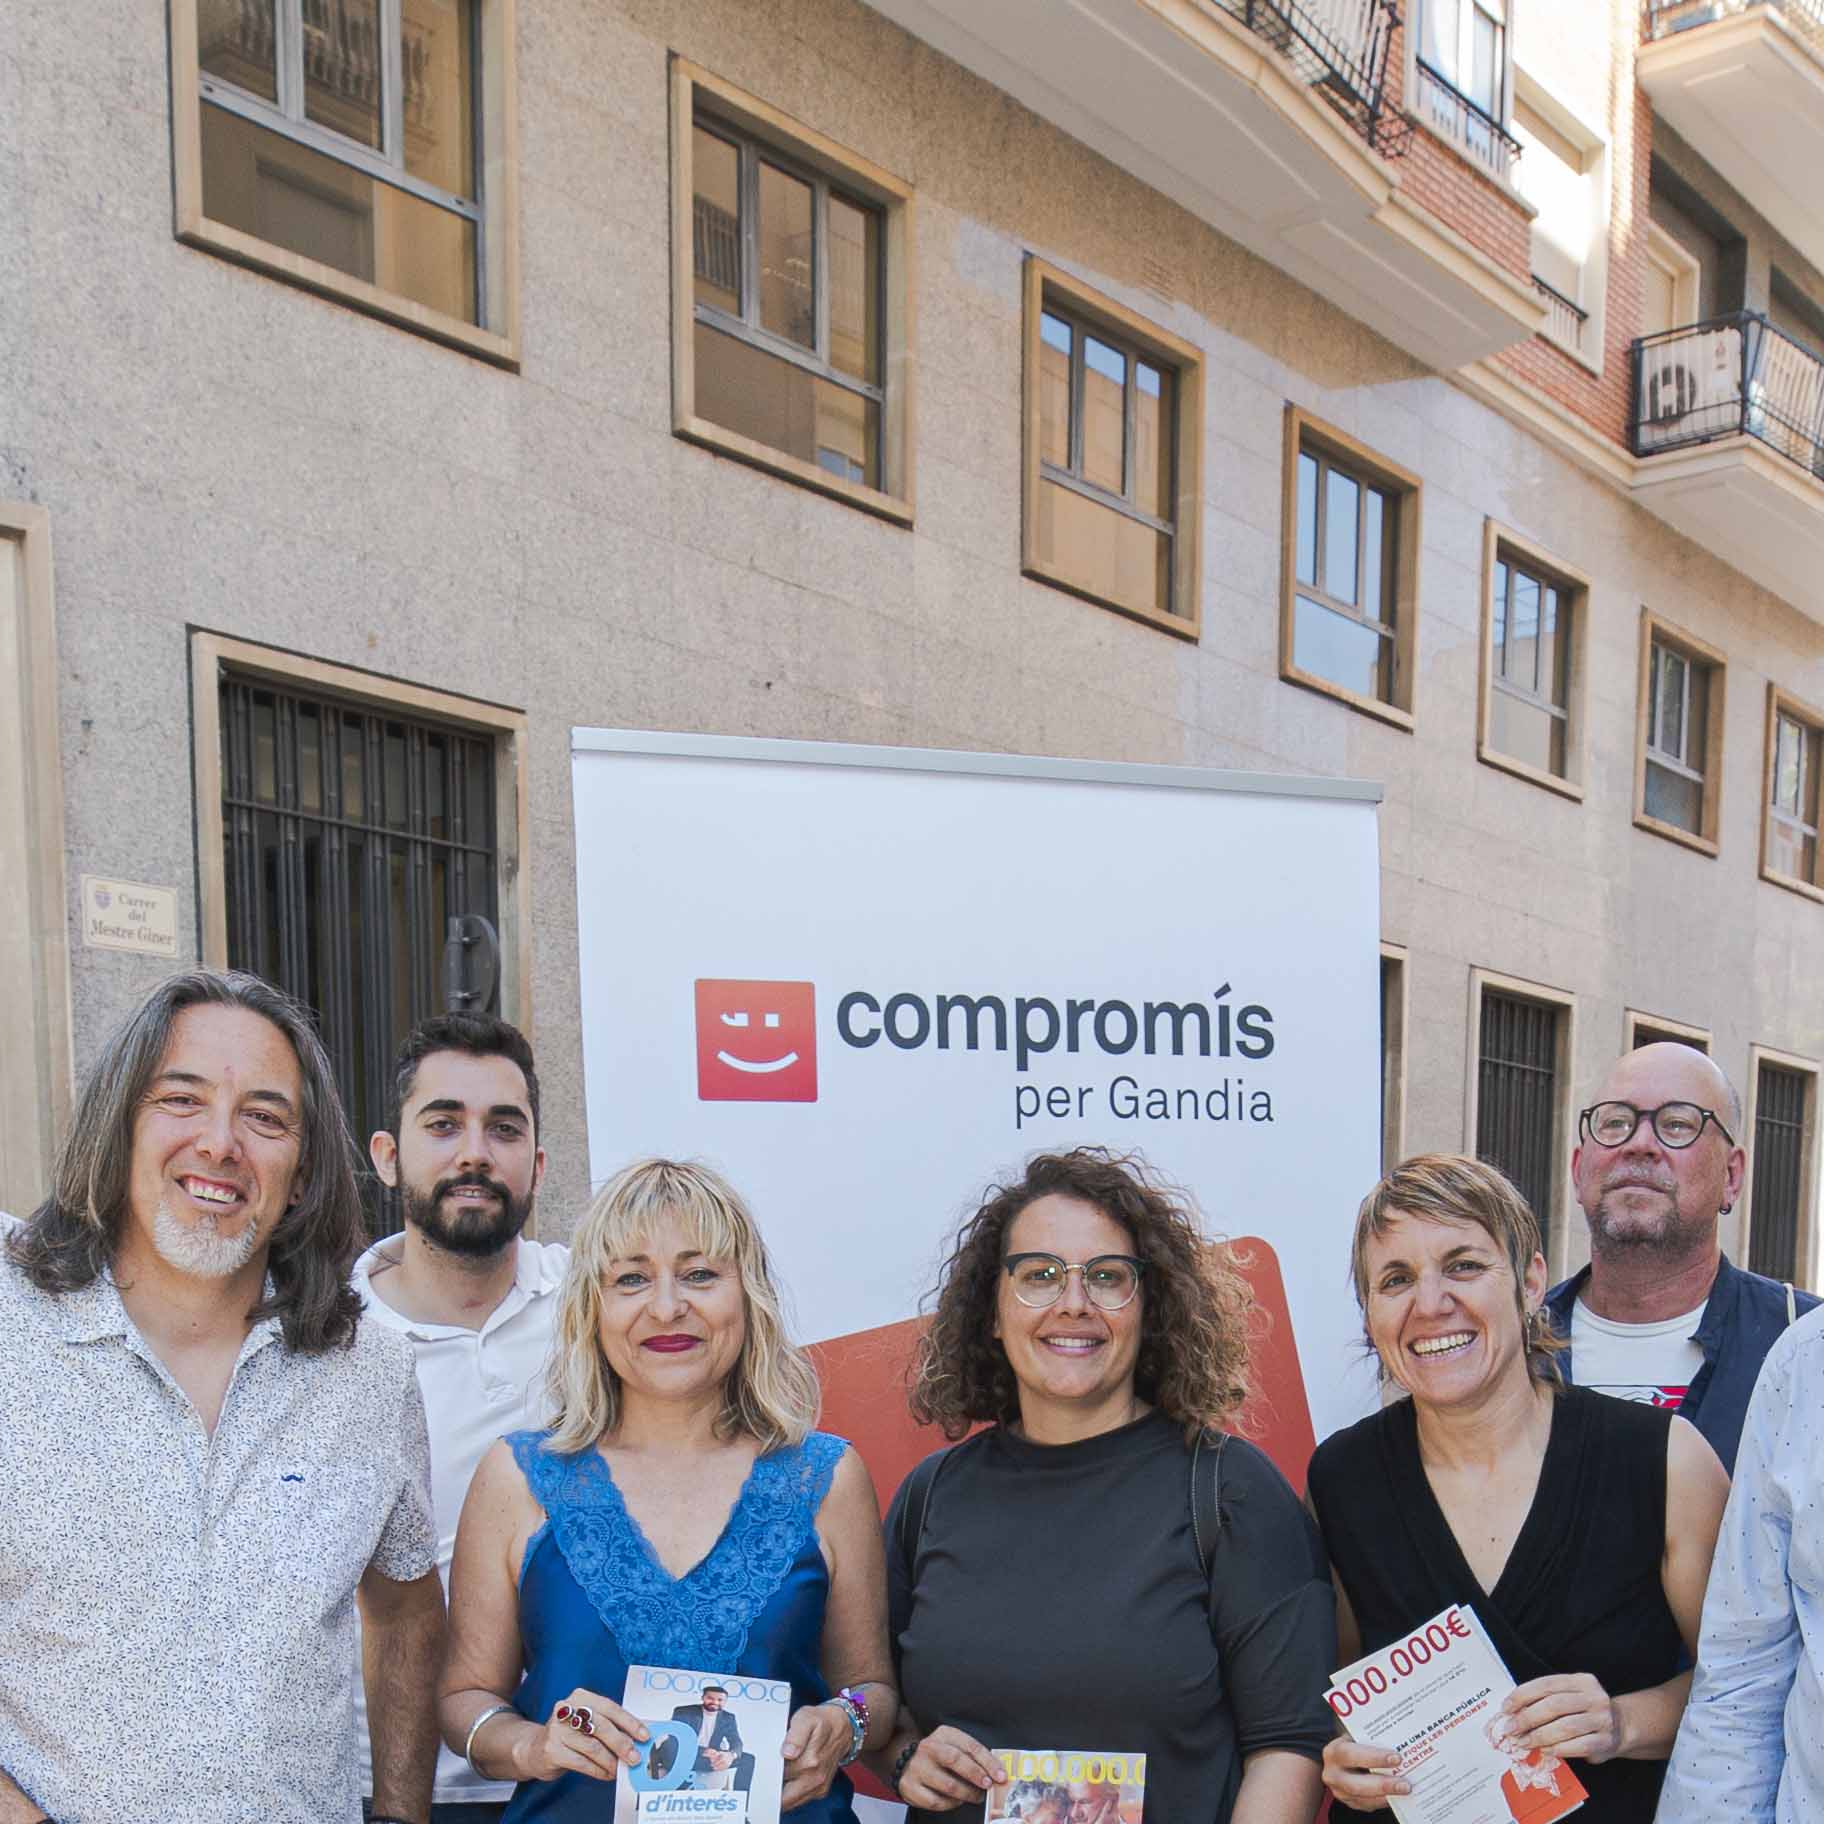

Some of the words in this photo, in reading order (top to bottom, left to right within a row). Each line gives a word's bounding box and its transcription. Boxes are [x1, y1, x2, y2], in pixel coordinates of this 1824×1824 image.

[117, 893, 158, 910] Carrer
[836, 982, 1275, 1072] compromís
[1015, 1084, 1094, 1130] per
[1108, 1075, 1275, 1123] Gandia
[1408, 1730, 1426, 1744] UNA
[1426, 1711, 1457, 1733] BANCA
[1402, 1746, 1434, 1769] CENTRE
